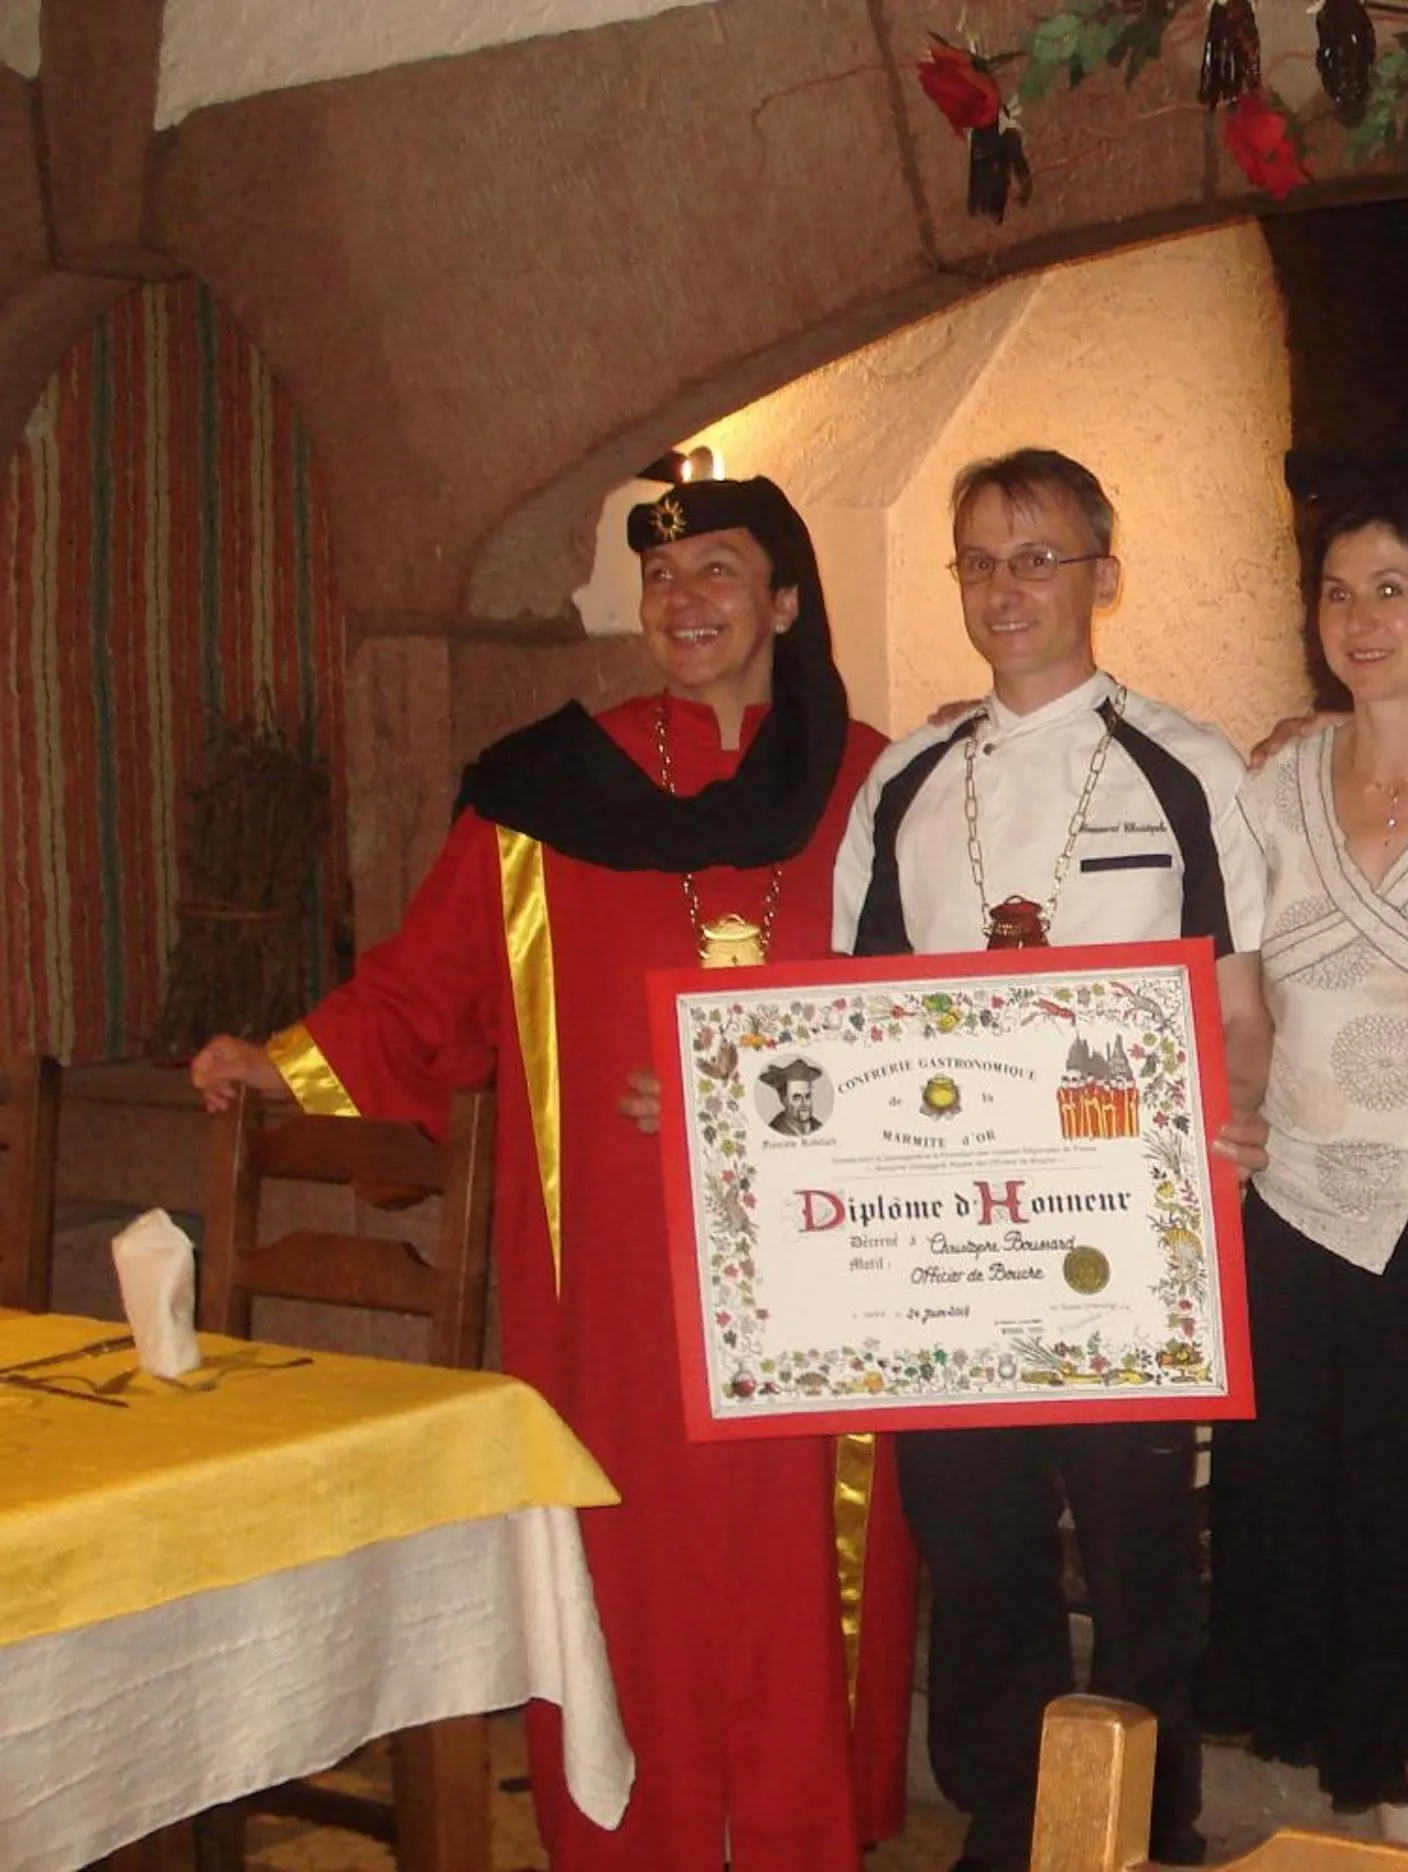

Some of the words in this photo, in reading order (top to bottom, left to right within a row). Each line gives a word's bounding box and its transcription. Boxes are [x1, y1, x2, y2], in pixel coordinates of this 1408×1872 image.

[917, 1056, 1037, 1082] GASTRONOMIQUE
[882, 1130, 947, 1148] MARMITE
[961, 1129, 997, 1147] d'OR
[966, 1268, 985, 1283] de
